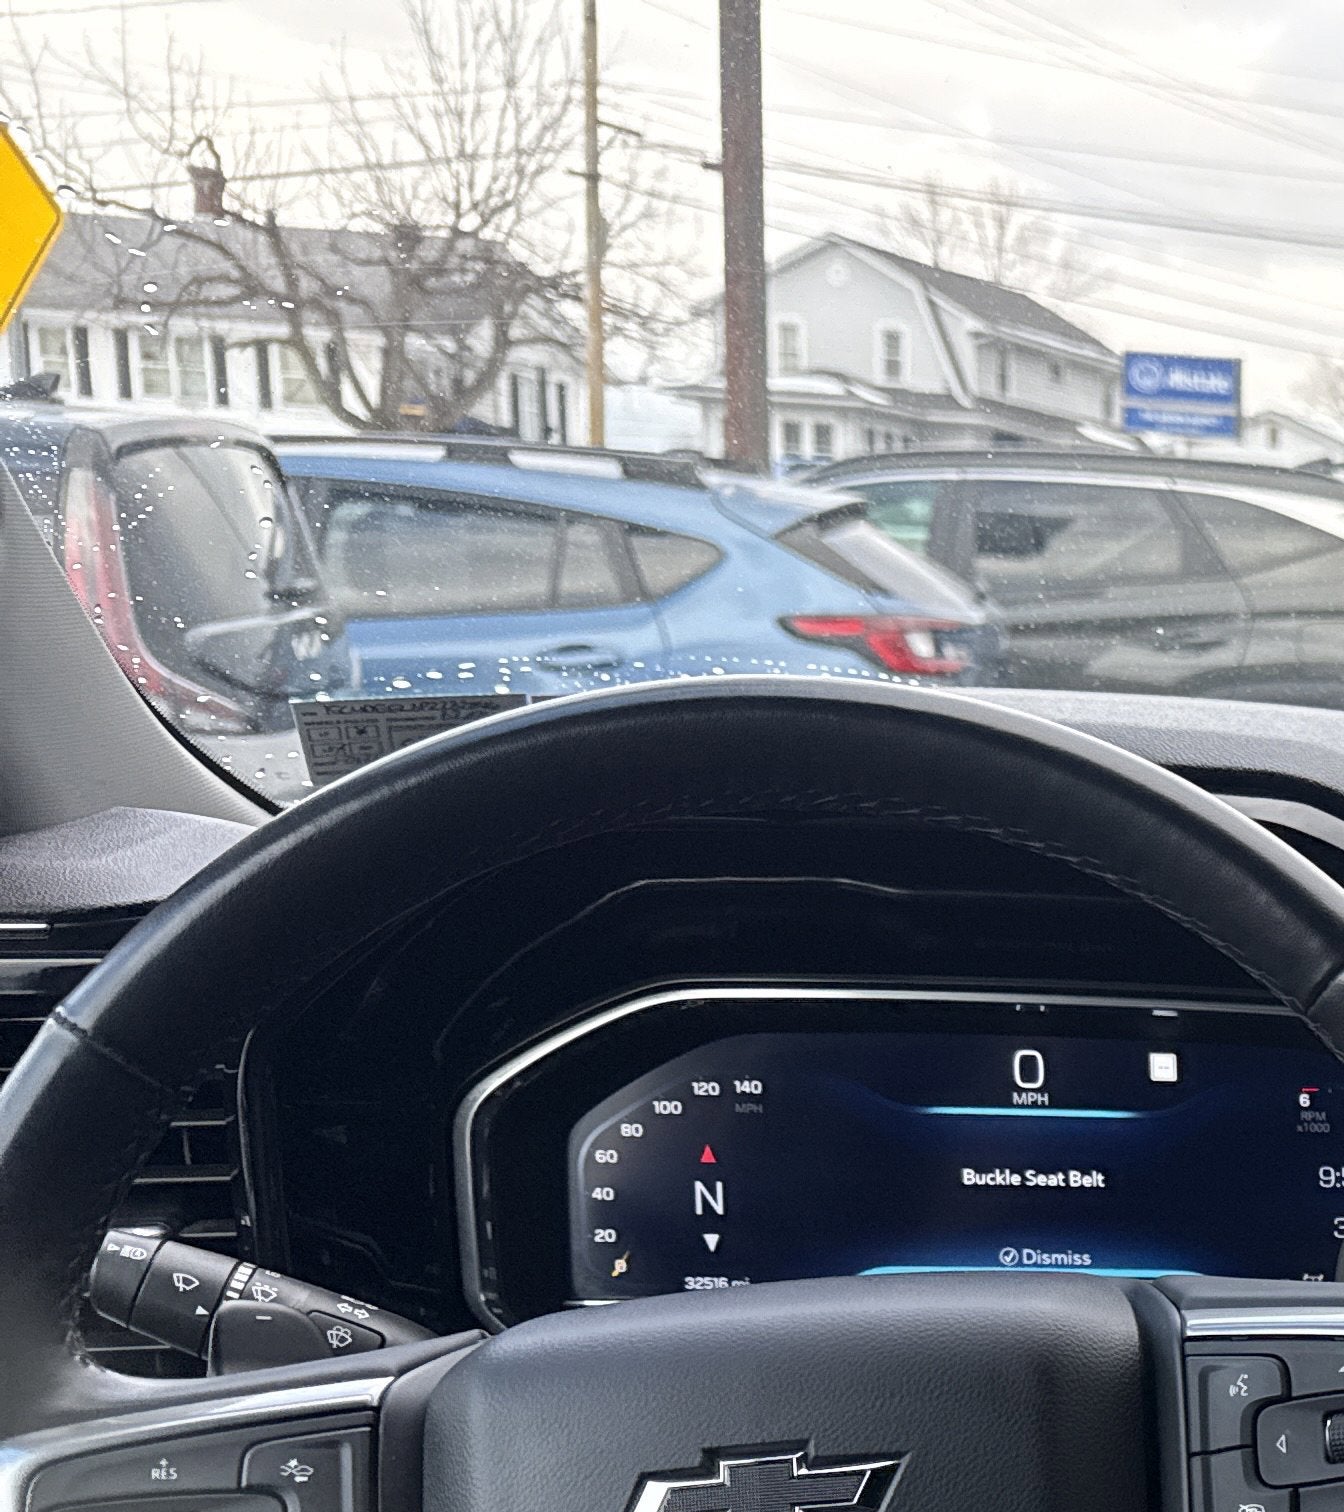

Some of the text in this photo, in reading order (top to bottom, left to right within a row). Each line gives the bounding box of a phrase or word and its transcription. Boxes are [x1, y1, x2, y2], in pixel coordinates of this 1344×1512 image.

[1013, 1049, 1045, 1089] 0
[691, 1081, 720, 1096] 120
[733, 1080, 763, 1095] 140
[1012, 1091, 1049, 1106] MPH
[1299, 1093, 1311, 1107] 6
[652, 1100, 683, 1115] 100
[734, 1103, 763, 1114] MPH
[1300, 1111, 1326, 1122] RPM
[620, 1123, 643, 1137] 80
[594, 1150, 618, 1164] 60
[961, 1168, 1106, 1188] Buckle Seat Belt
[591, 1187, 615, 1201] 40
[693, 1180, 724, 1216] N
[594, 1228, 617, 1243] 20
[1022, 1248, 1092, 1266] Dismiss
[684, 1277, 729, 1290] 32516
[151, 1467, 178, 1480] RES
